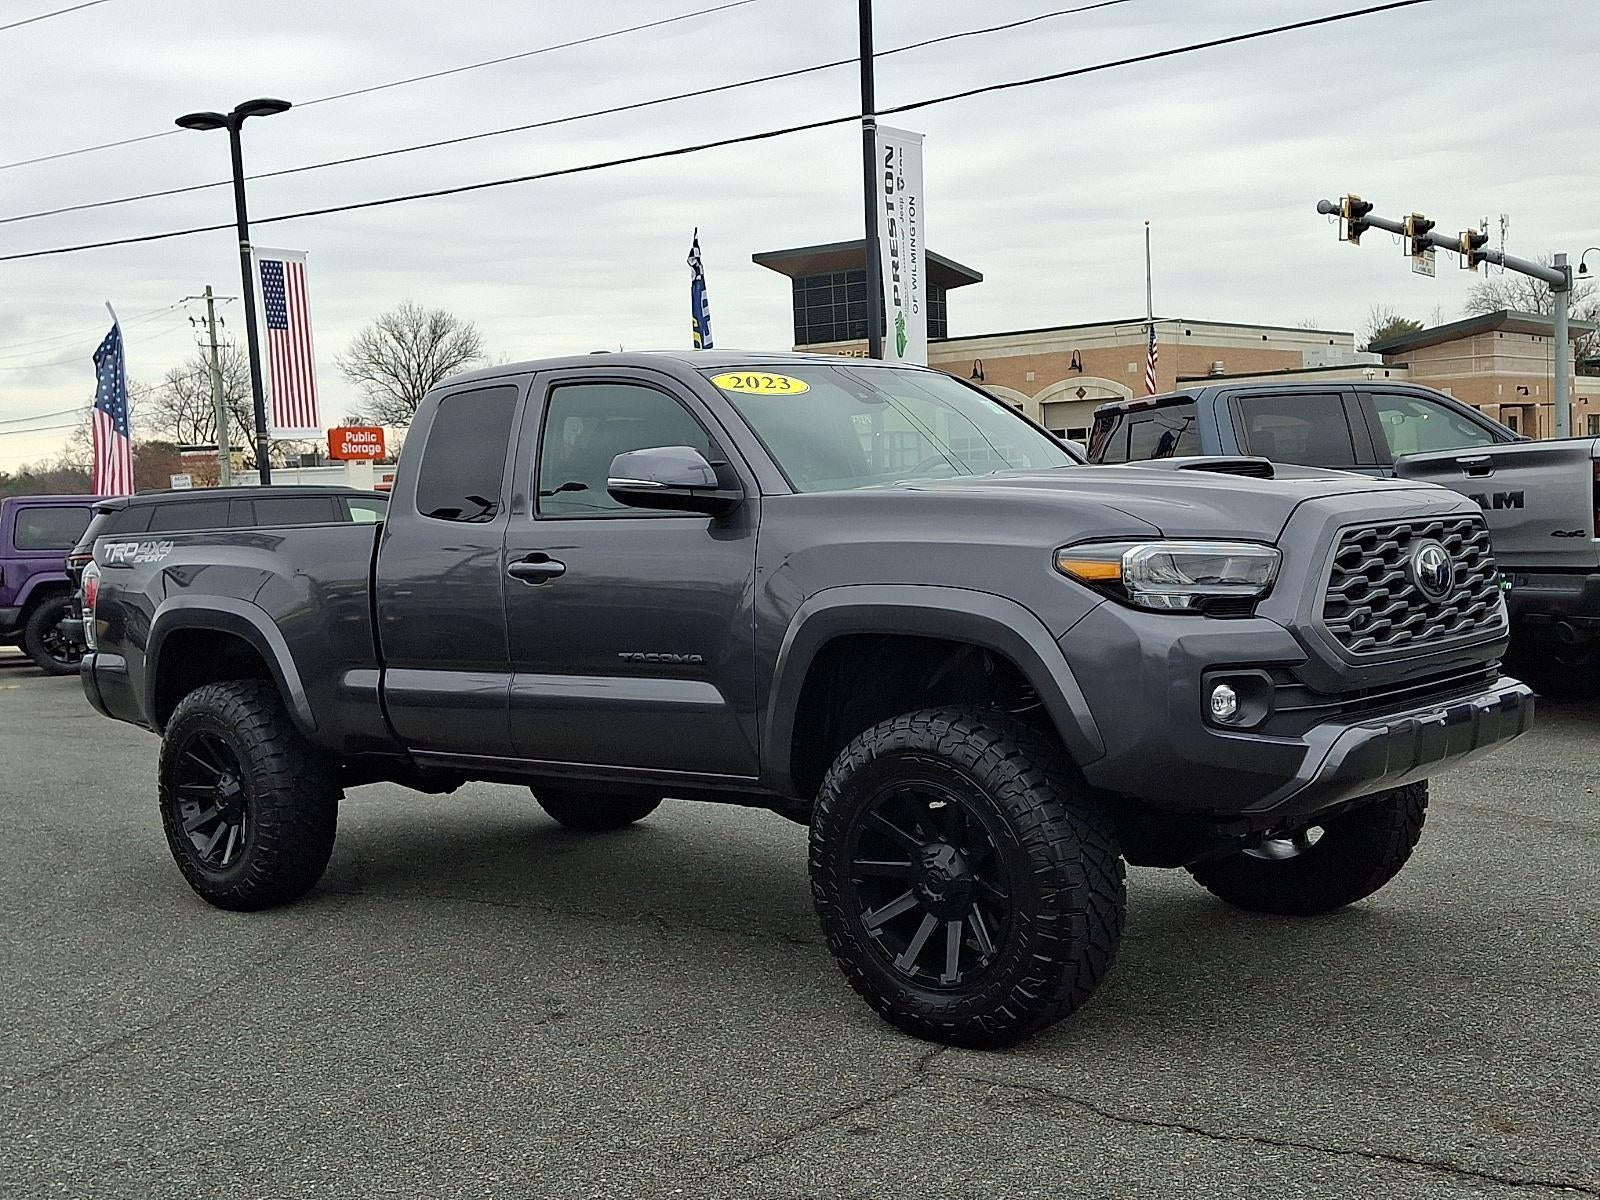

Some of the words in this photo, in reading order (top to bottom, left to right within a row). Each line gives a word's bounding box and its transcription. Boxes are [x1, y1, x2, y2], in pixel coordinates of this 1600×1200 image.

[884, 145, 902, 307] PRESTON
[908, 196, 918, 290] WILMINGTON
[912, 294, 919, 315] OF
[729, 376, 791, 390] 2023
[345, 431, 377, 442] Public
[341, 442, 381, 456] Storage
[1468, 490, 1524, 510] AM
[103, 542, 139, 563] TRD
[133, 553, 168, 563] SPORT
[618, 652, 704, 664] TACOMA
